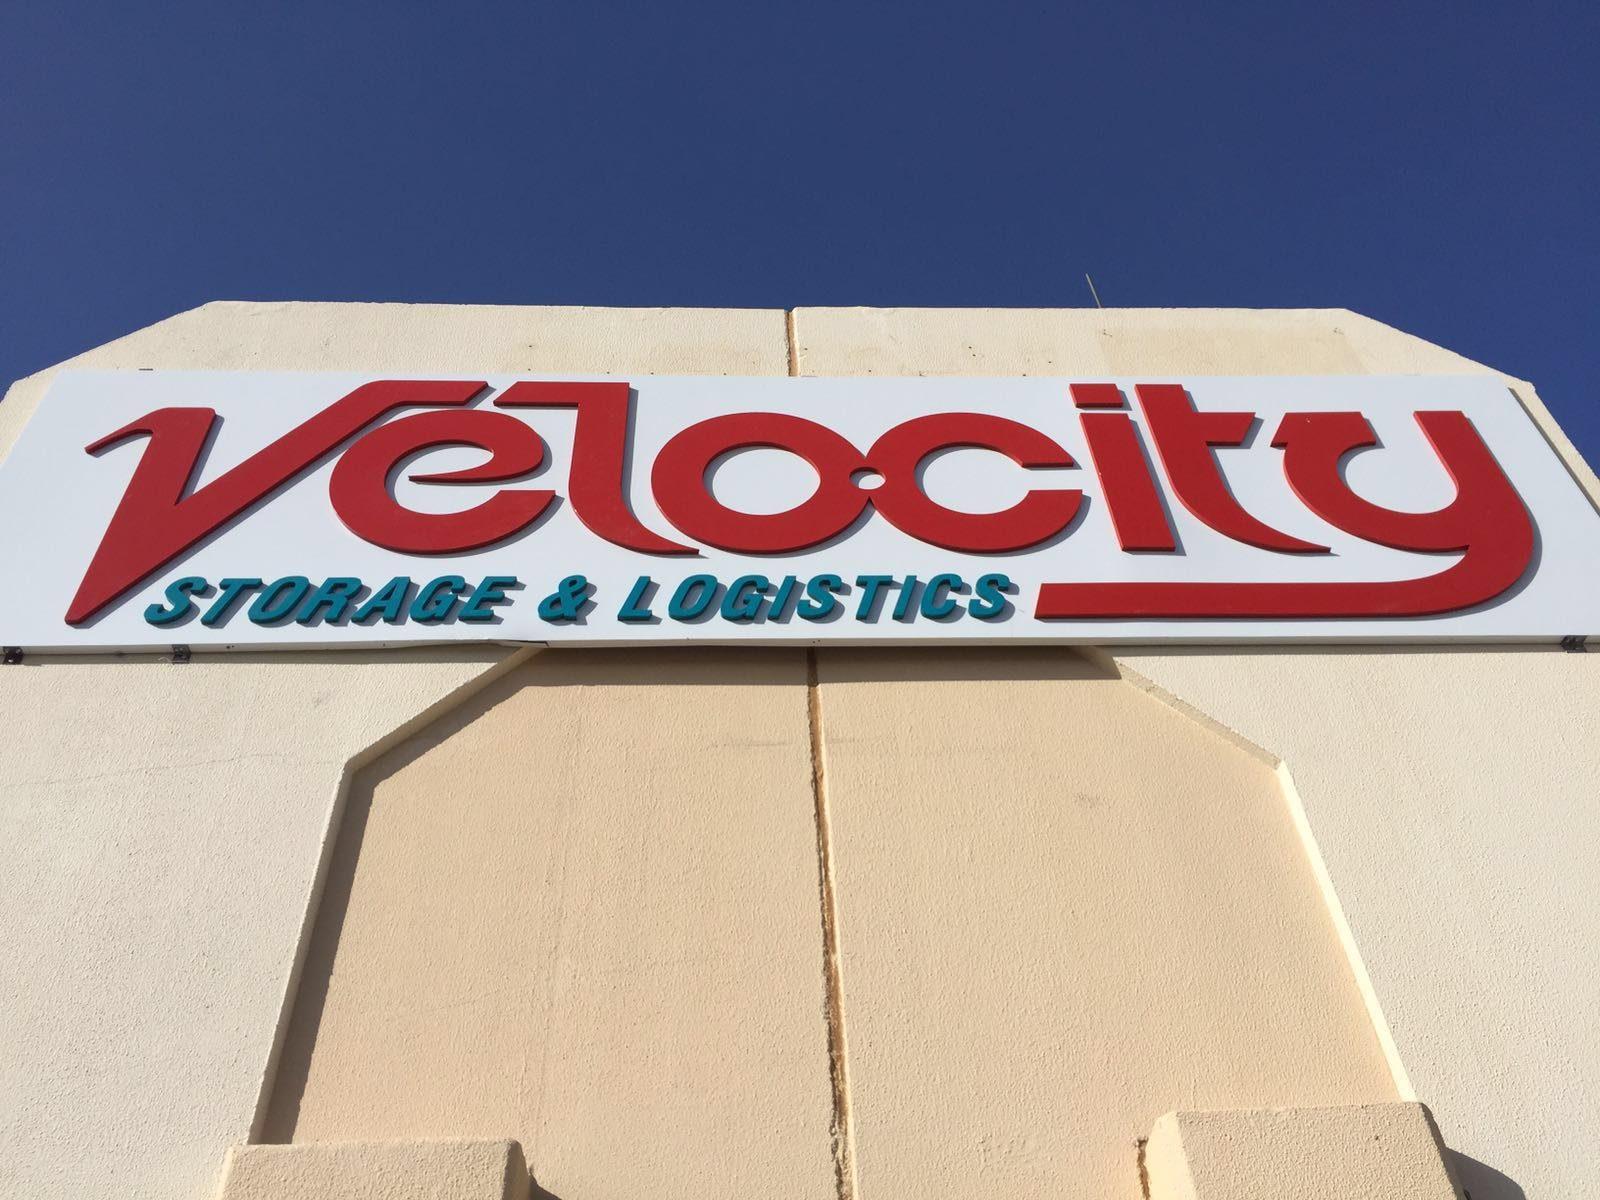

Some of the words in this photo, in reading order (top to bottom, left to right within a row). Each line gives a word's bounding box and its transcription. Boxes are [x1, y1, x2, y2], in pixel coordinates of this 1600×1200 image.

[66, 380, 1535, 622] Velocity
[144, 575, 518, 624] STORAGE
[538, 575, 590, 622] &
[618, 573, 1013, 622] LOGISTICS
